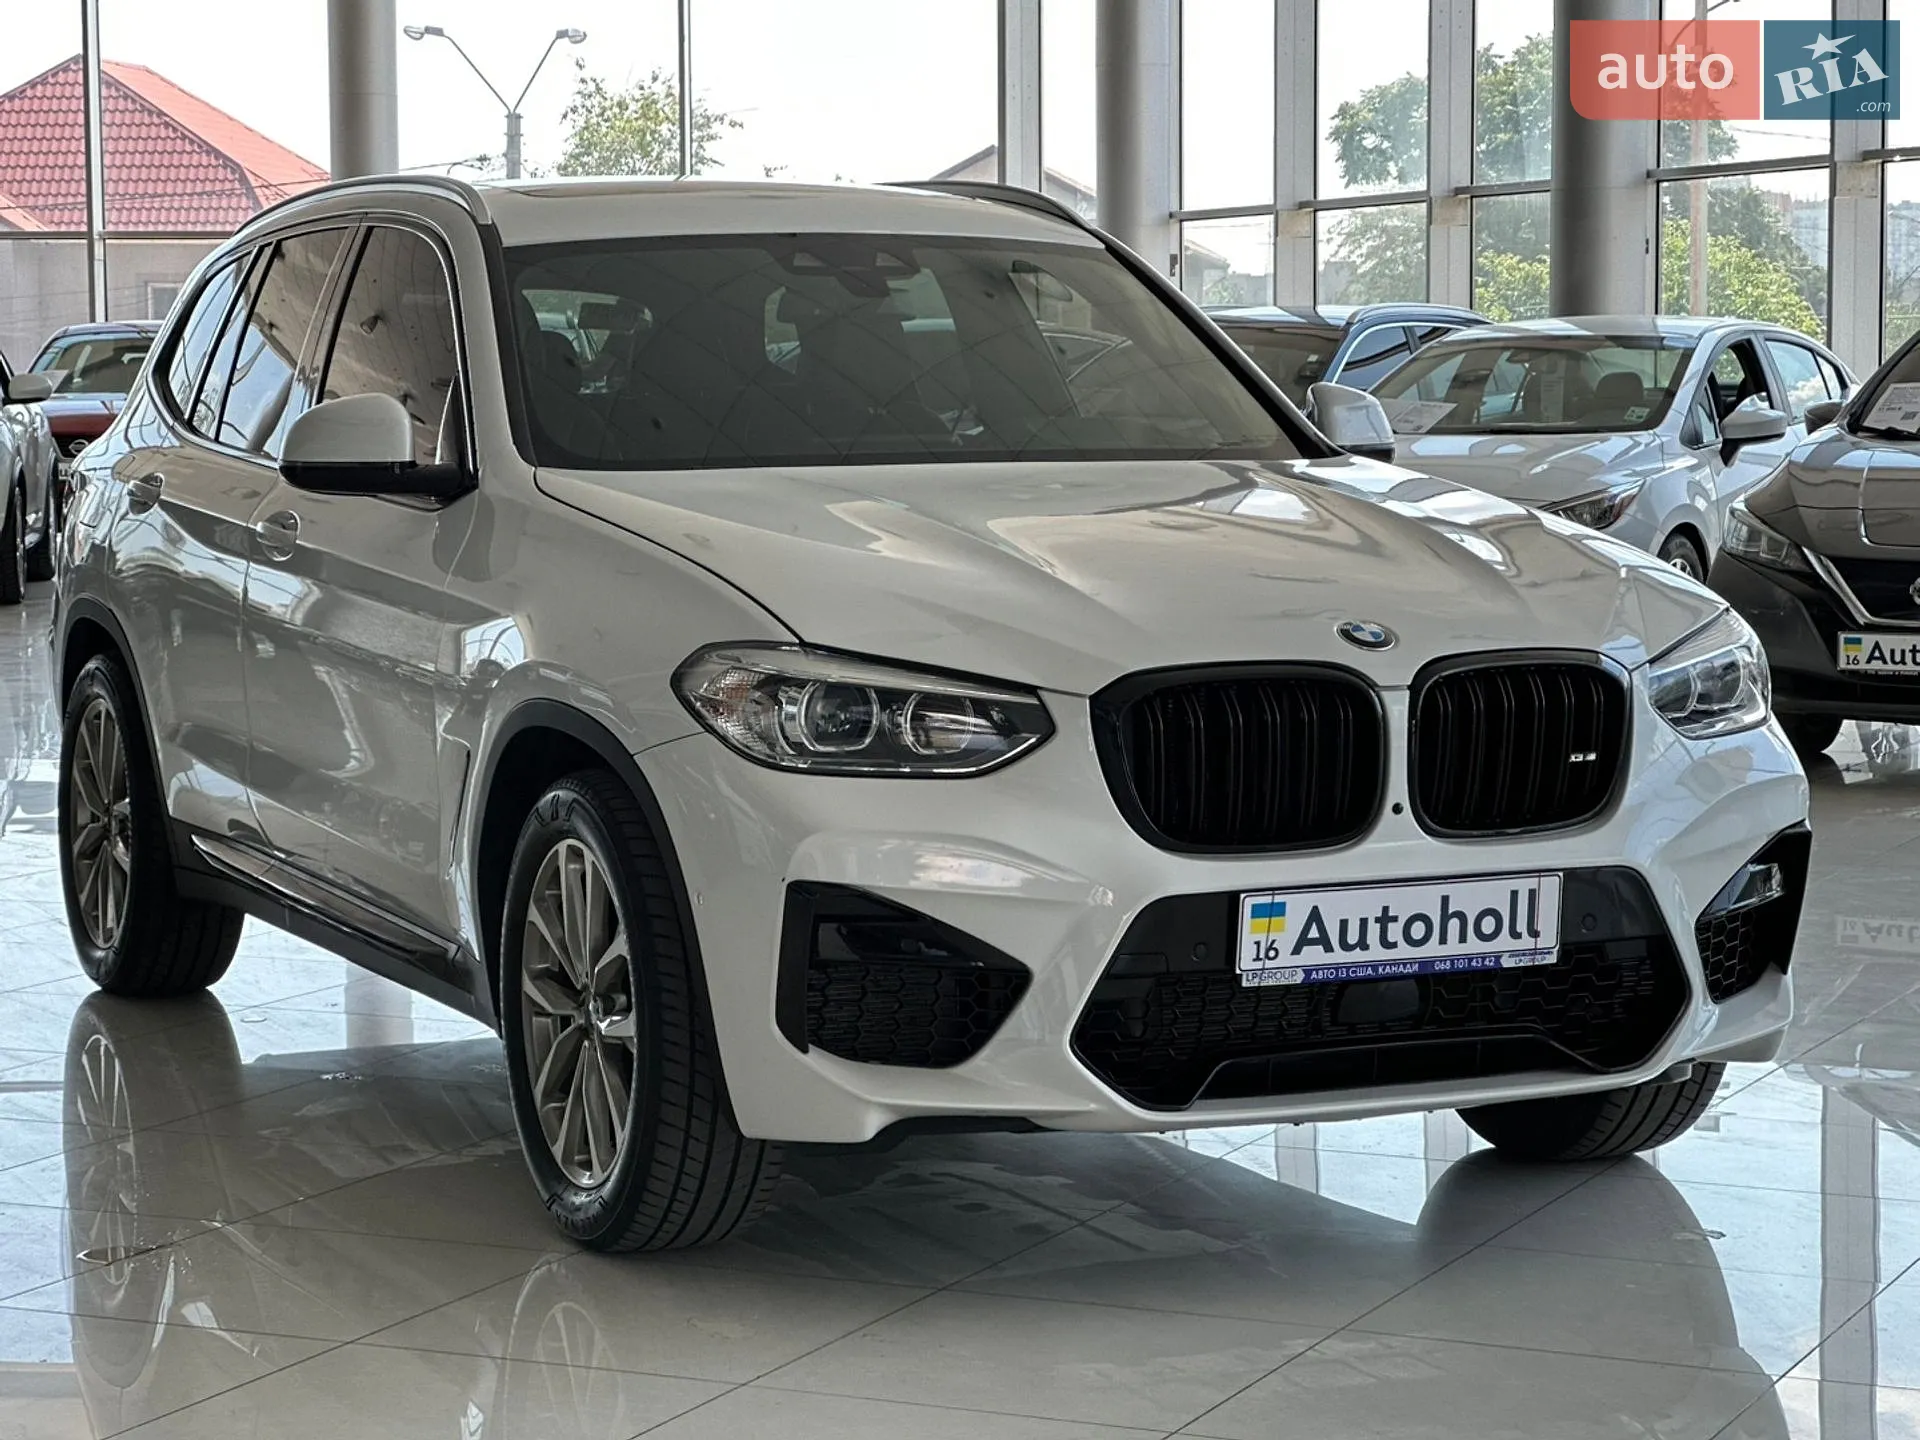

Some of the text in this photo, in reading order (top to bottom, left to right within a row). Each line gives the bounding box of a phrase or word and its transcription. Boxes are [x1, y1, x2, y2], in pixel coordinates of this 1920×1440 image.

[1845, 654, 1860, 666] 16
[1290, 887, 1541, 956] Autoholl
[1252, 939, 1280, 963] 16
[1310, 970, 1335, 980] АВТО
[1378, 963, 1419, 975] КАНАДИ
[1434, 961, 1451, 971] 068
[1454, 959, 1468, 969] 101
[1470, 958, 1482, 968] 43
[1484, 957, 1495, 967] 42
